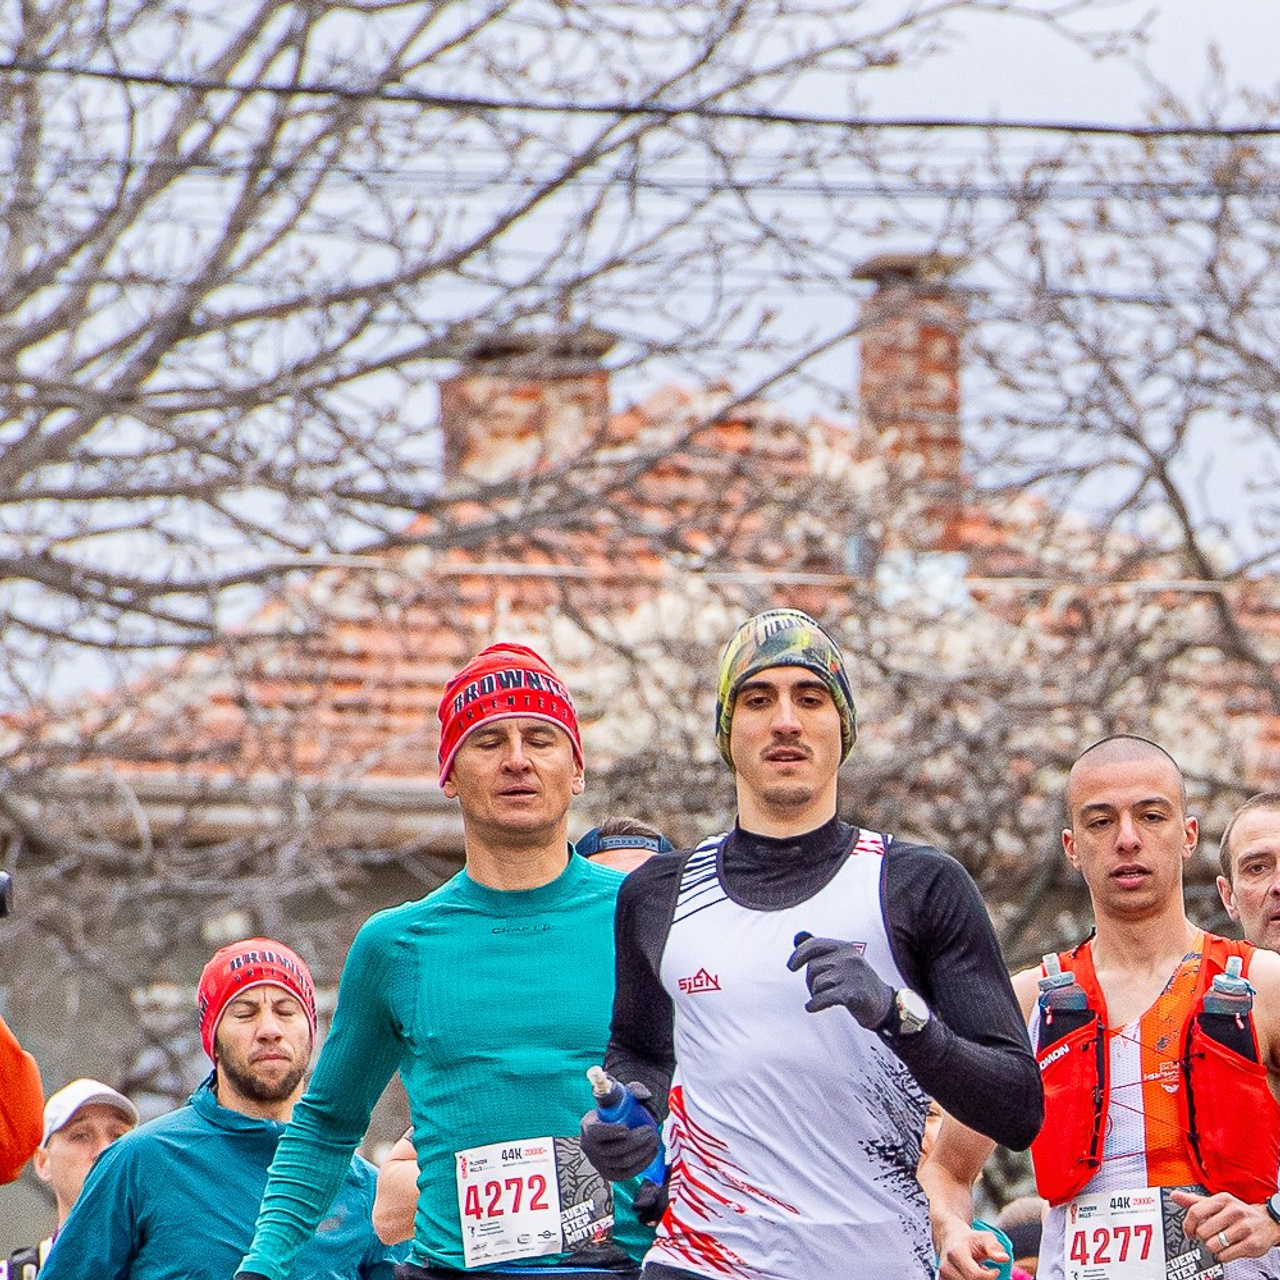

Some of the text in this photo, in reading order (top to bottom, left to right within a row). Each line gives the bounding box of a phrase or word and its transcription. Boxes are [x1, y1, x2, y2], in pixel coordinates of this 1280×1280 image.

[501, 1148, 523, 1161] 44K
[464, 1175, 549, 1220] 4272
[1109, 1197, 1130, 1210] 44K
[560, 1199, 595, 1224] EVERY
[562, 1213, 592, 1234] STEP
[1070, 1224, 1153, 1265] 4277
[1166, 1248, 1202, 1272] EVERY
